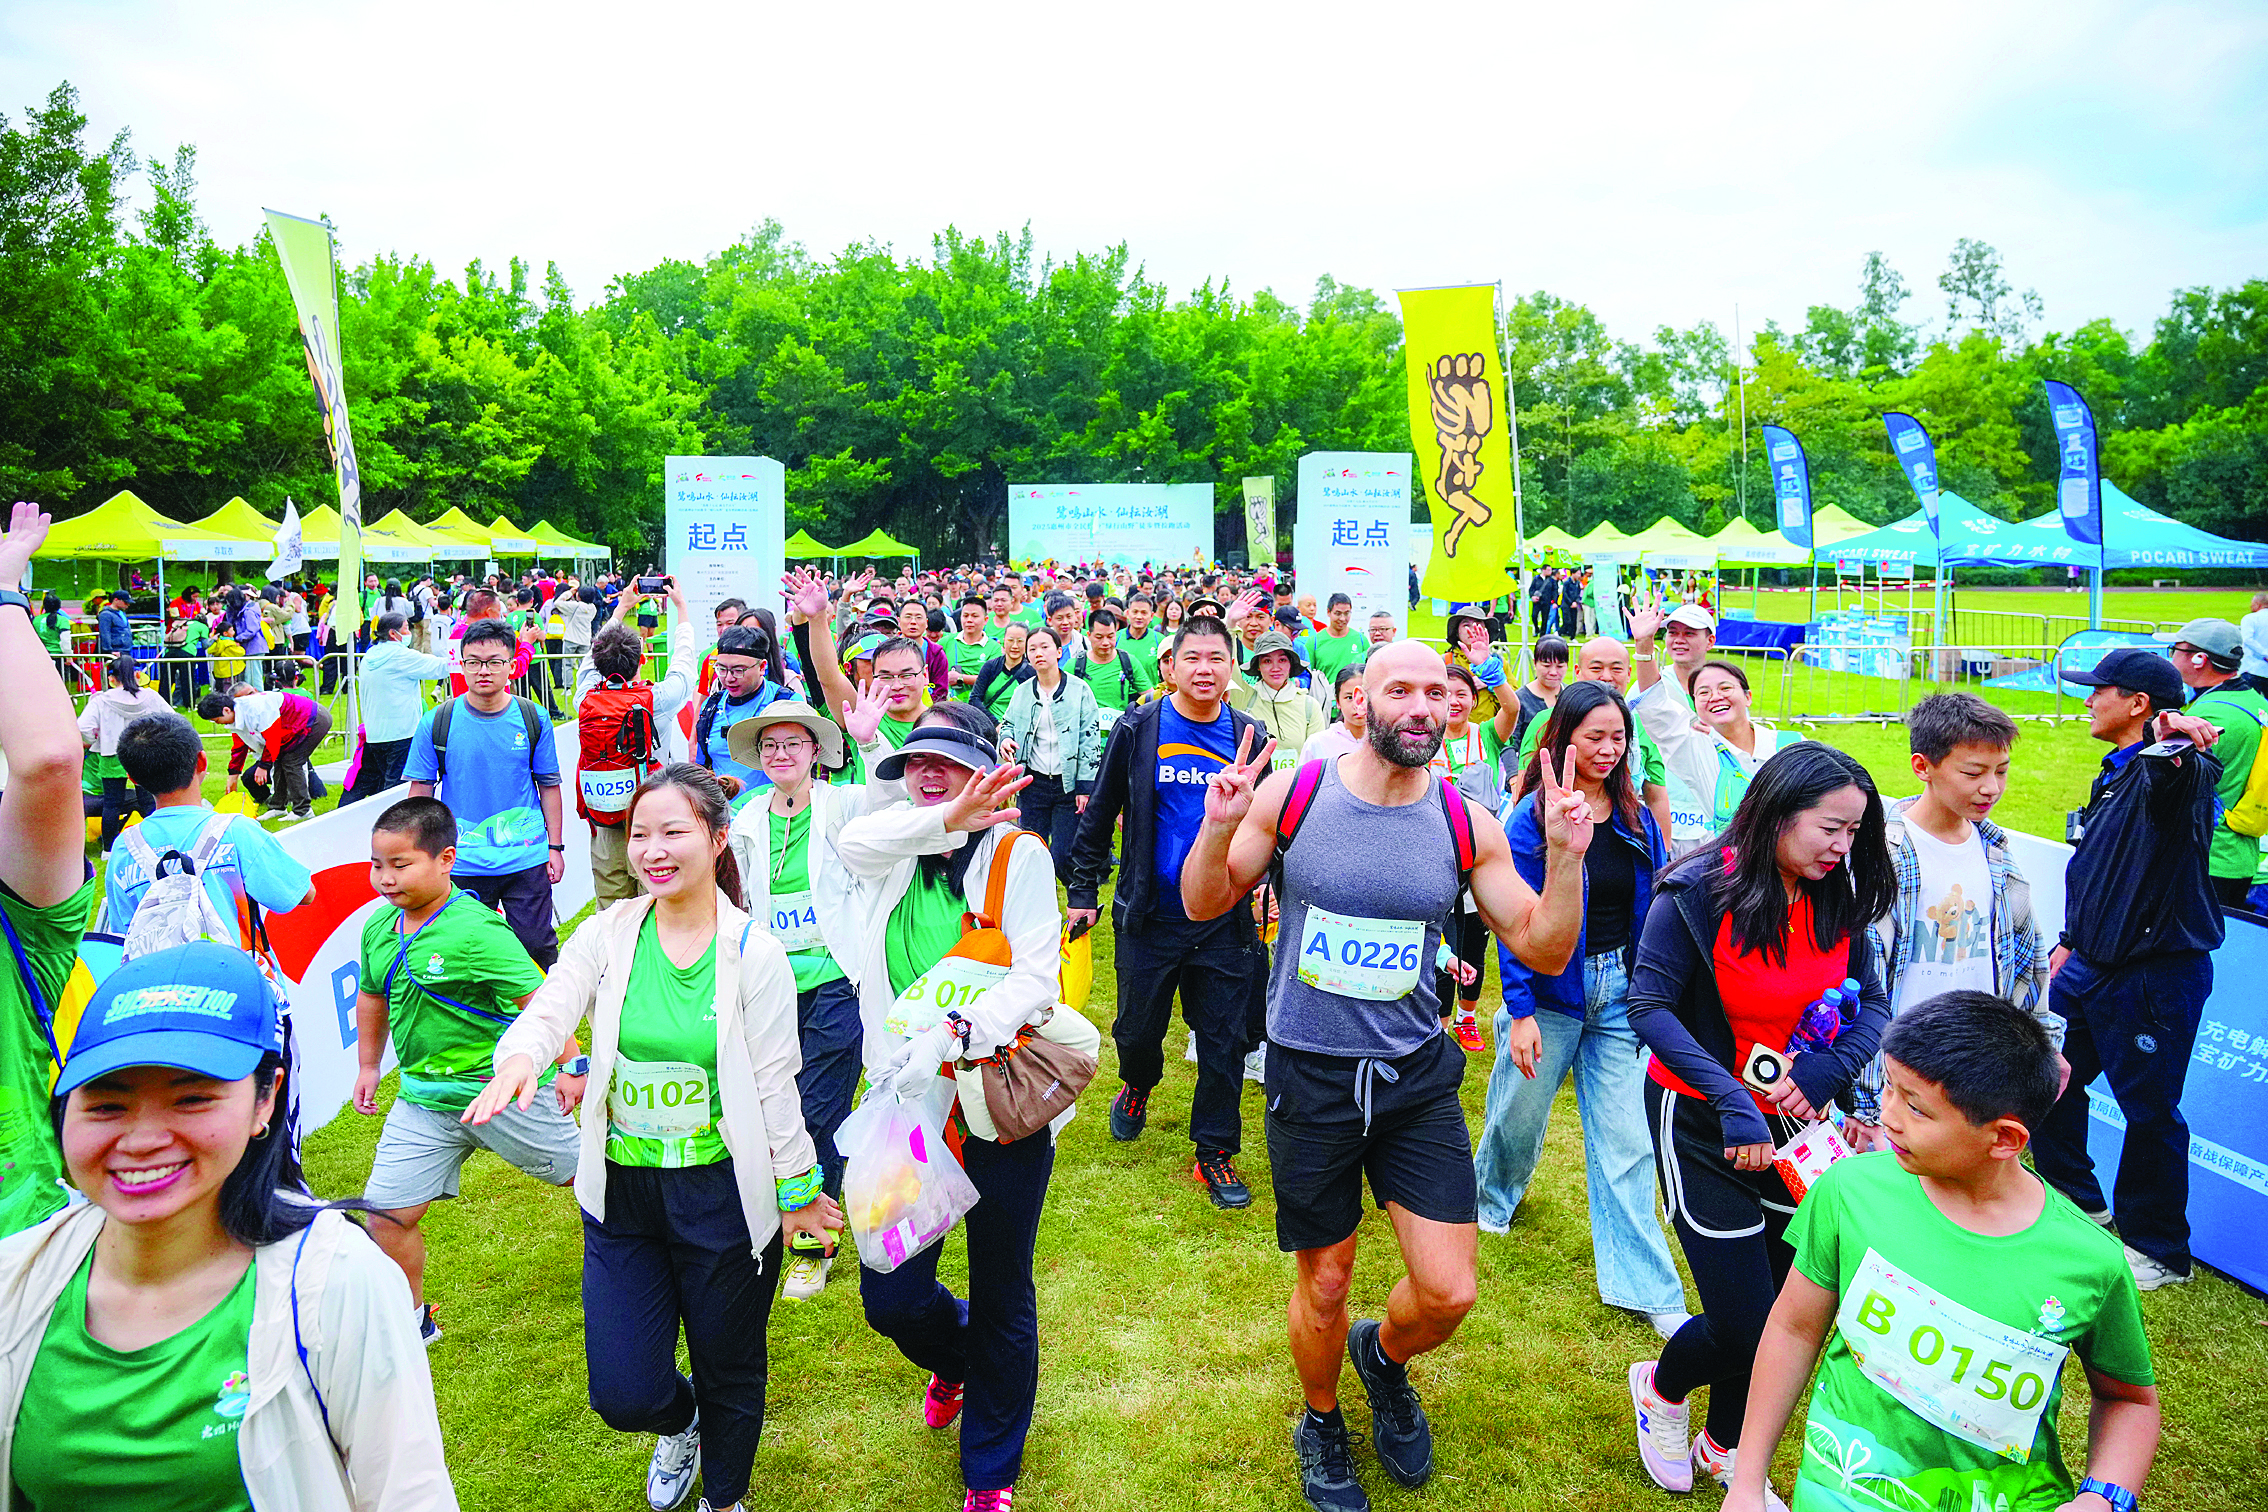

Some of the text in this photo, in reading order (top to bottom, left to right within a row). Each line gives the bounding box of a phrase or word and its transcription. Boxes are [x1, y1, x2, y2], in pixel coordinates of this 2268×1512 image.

[688, 522, 748, 550] 起点
[1332, 518, 1389, 547] 起点
[1871, 548, 1917, 560] SWEAT
[2131, 551, 2255, 565] POCARI SWEAT
[584, 780, 635, 796] A 0259
[1305, 931, 1418, 971] A 0226
[905, 976, 928, 1001] B
[622, 1080, 705, 1109] 0102
[1856, 1287, 2045, 1410] B 0150
